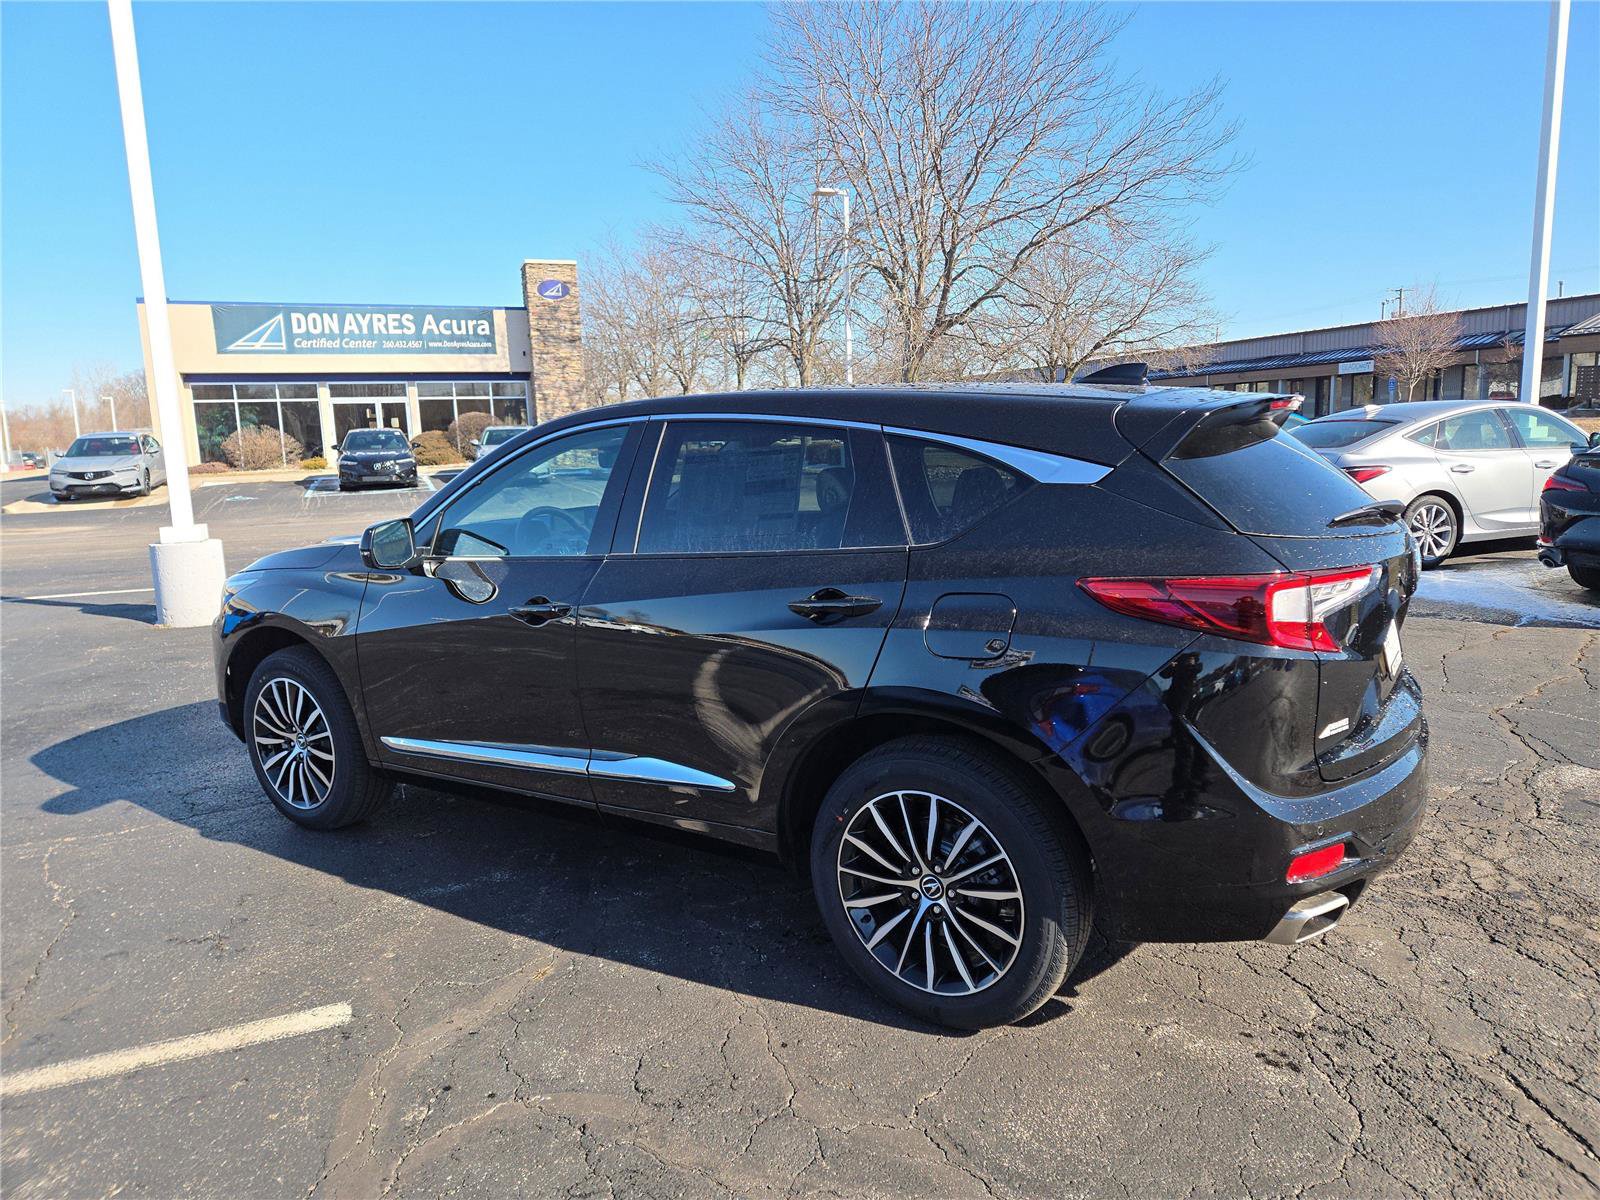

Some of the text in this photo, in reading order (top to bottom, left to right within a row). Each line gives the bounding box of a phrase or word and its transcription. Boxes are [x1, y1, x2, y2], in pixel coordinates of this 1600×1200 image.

[291, 312, 490, 335] DON AYRES Acura
[293, 338, 340, 348] Certified
[342, 338, 377, 348] Center
